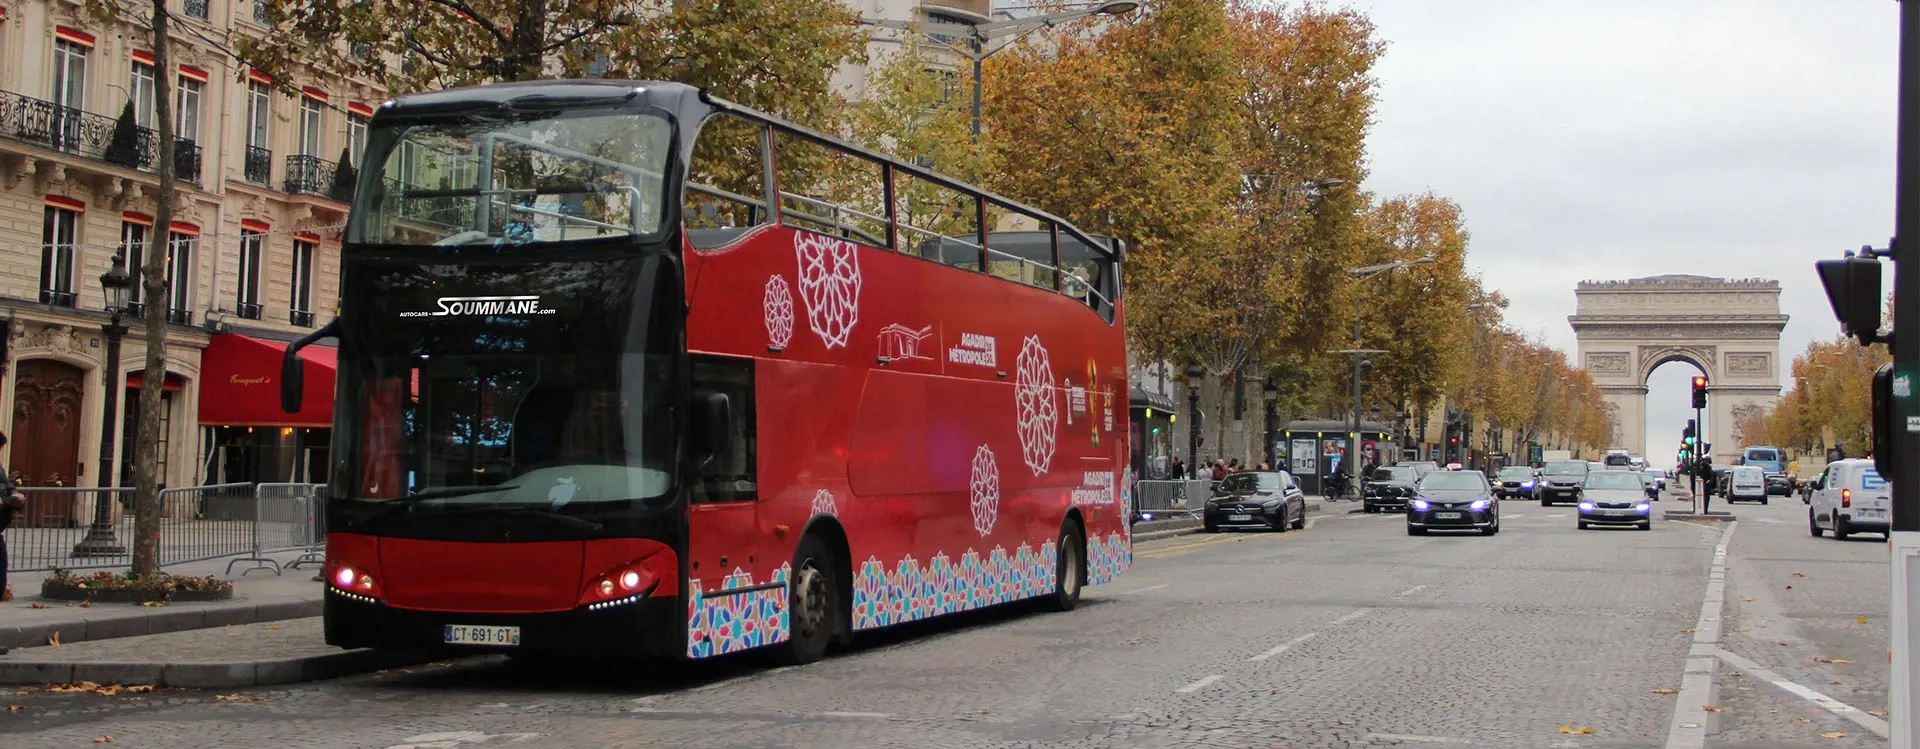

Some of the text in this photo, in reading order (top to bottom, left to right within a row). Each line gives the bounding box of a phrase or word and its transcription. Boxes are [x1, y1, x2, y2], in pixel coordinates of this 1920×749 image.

[961, 332, 985, 349] AGADIR
[949, 344, 986, 366] MÉTROPOLE
[1083, 471, 1105, 486] AGADIR
